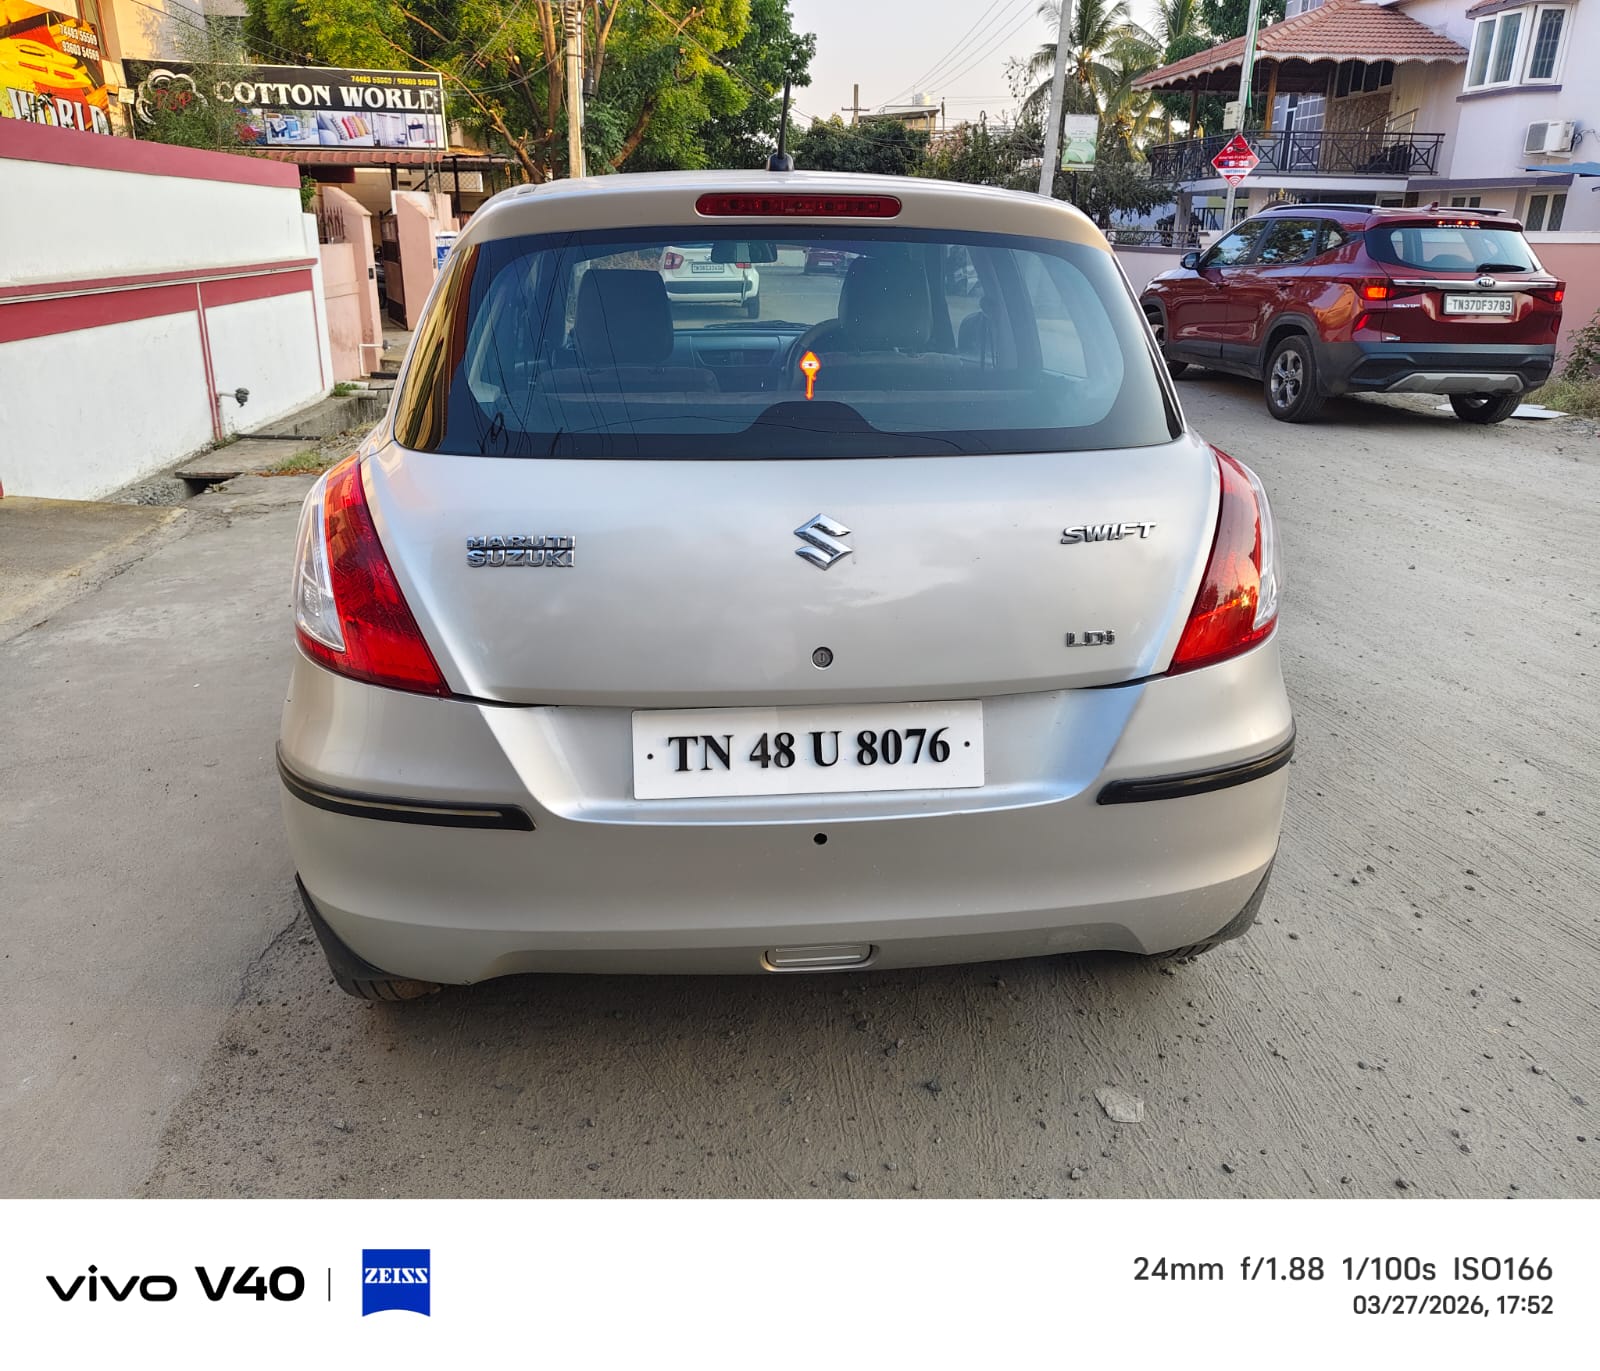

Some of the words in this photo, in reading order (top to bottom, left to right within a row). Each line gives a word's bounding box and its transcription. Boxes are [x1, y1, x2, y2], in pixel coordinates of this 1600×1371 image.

[214, 81, 331, 106] COTTON
[466, 535, 576, 549] MARUTI
[1060, 521, 1156, 544] SWIFT
[466, 549, 575, 567] SUZUKI
[667, 734, 735, 772] TN
[749, 731, 796, 769] 48
[809, 730, 843, 767] U
[856, 726, 951, 766] 8076
